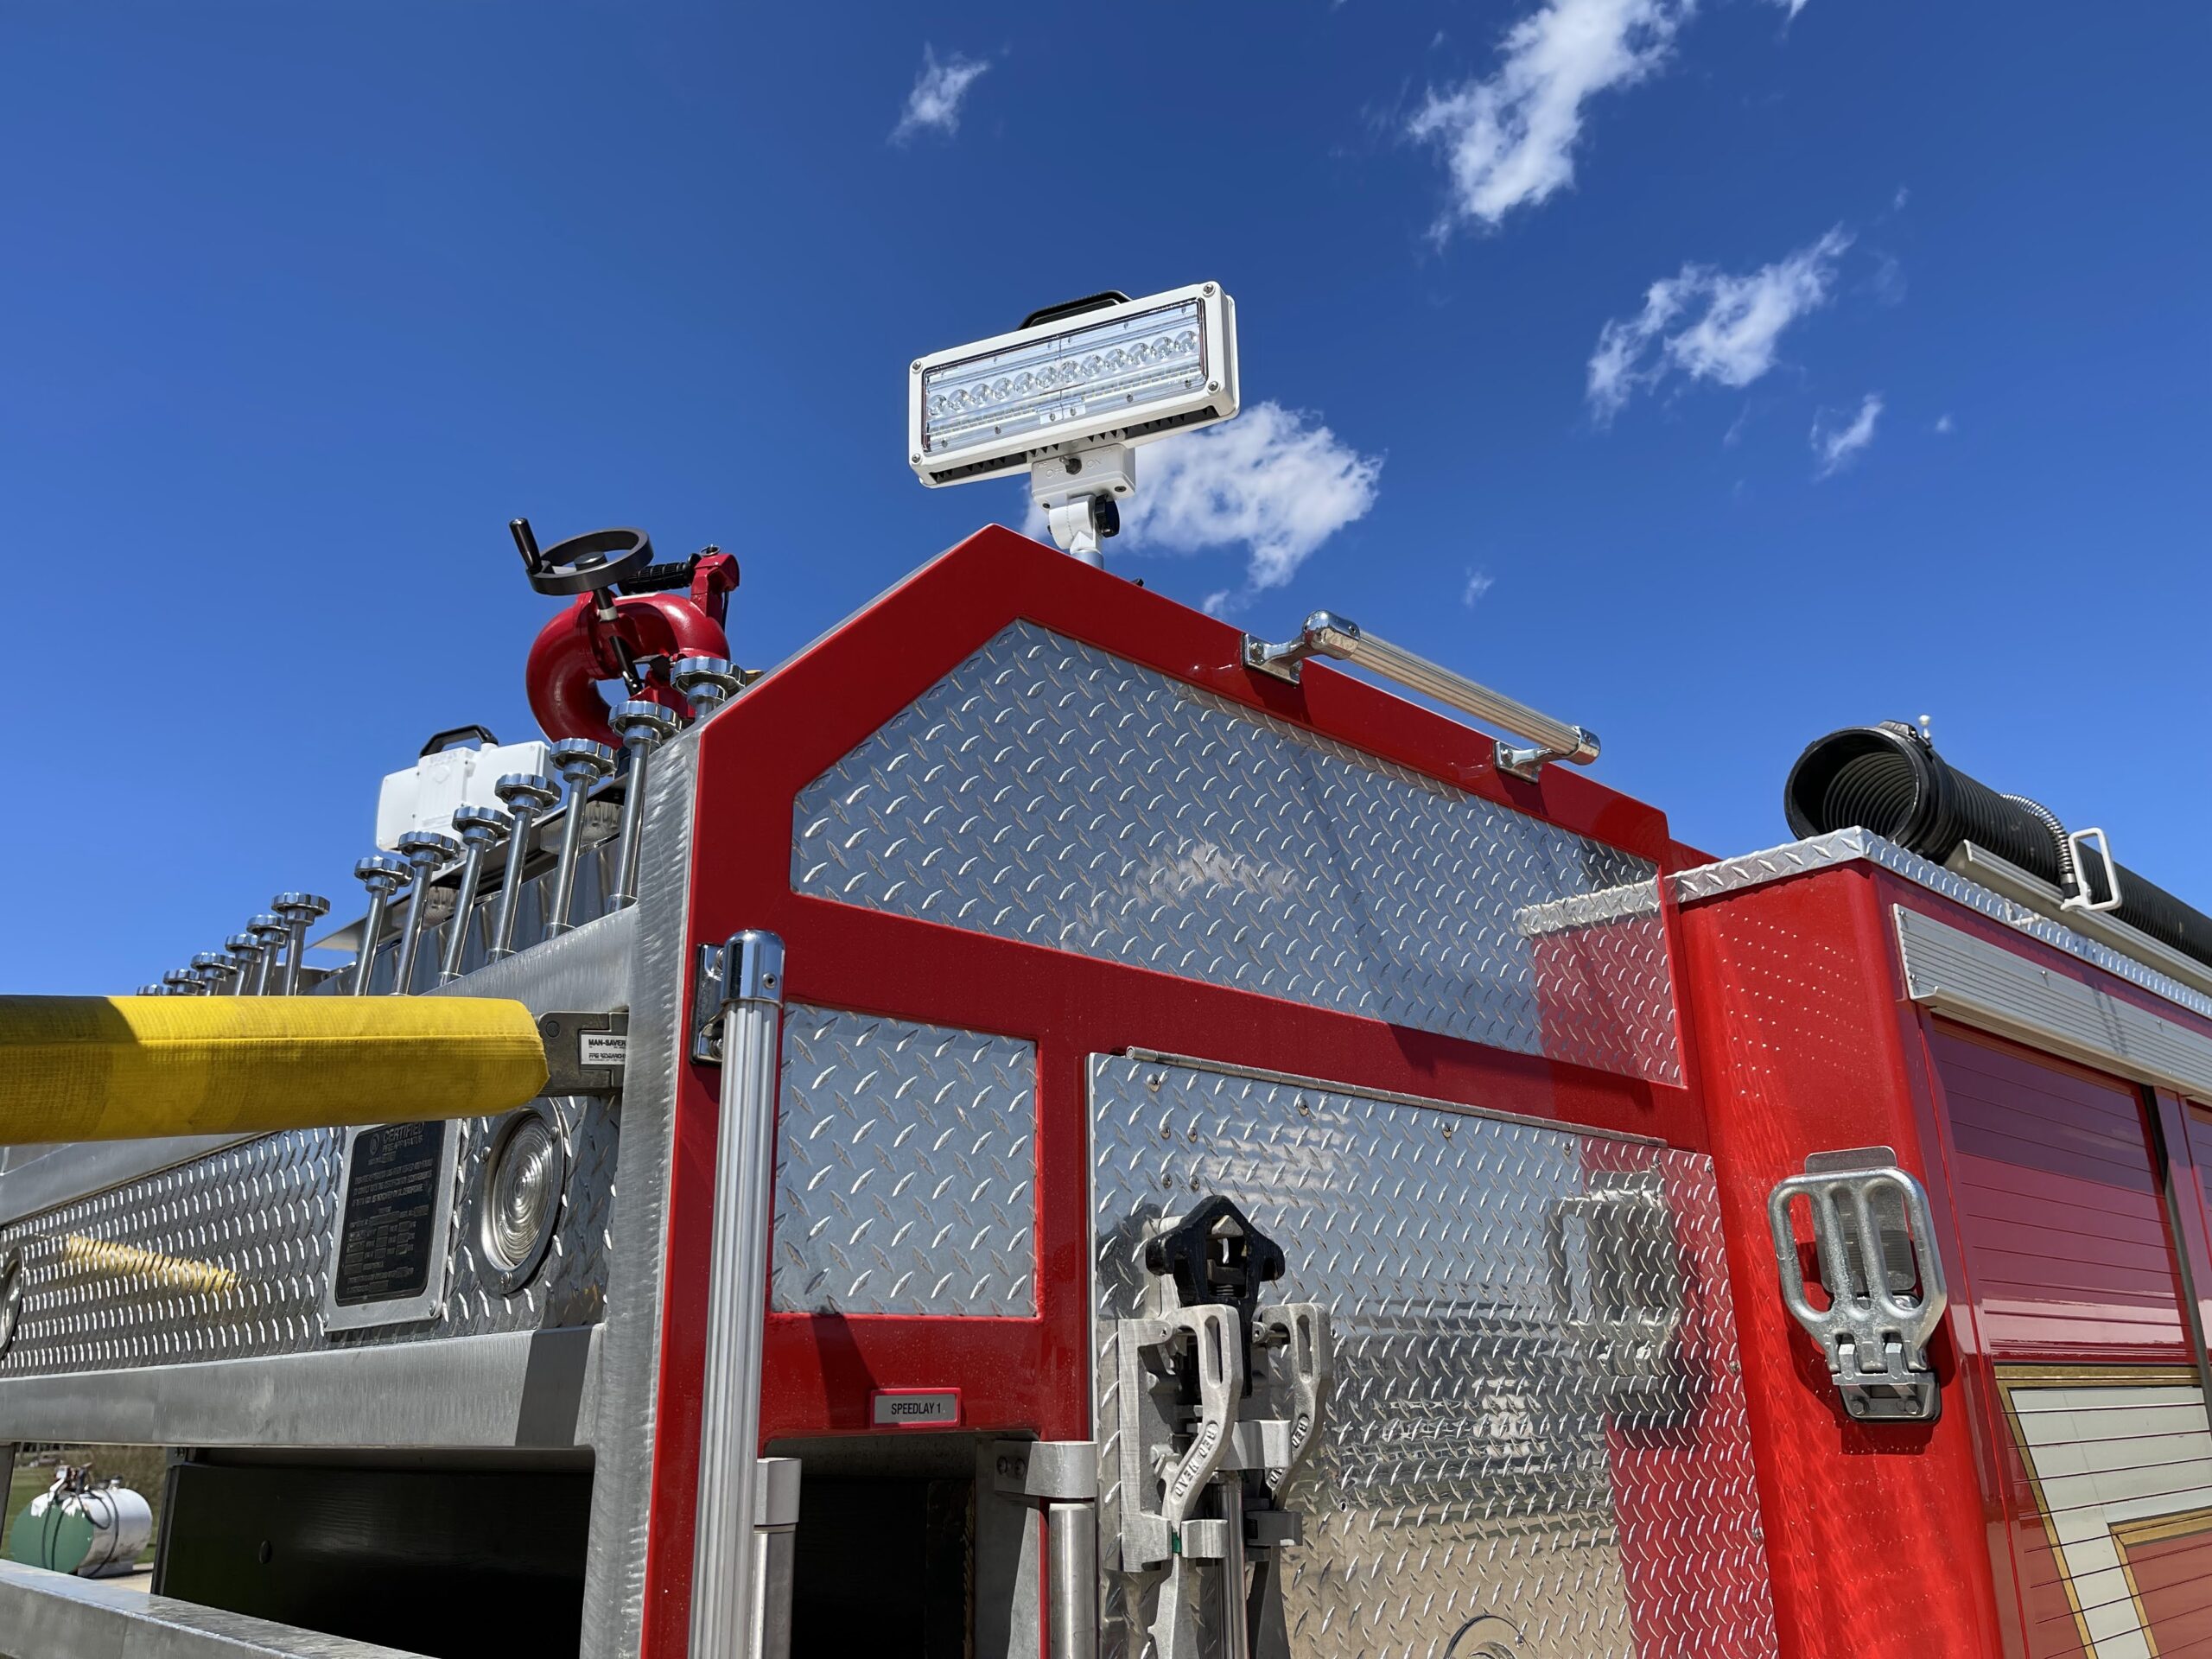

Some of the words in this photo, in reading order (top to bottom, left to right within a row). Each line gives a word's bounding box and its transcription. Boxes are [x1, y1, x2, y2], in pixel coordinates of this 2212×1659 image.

[383, 1122, 425, 1144] CERTIFIED
[891, 1402, 935, 1415] SPEEDLAY
[937, 1402, 941, 1414] 1
[1198, 1428, 1217, 1459] RED
[1174, 1459, 1200, 1497] HEAD
